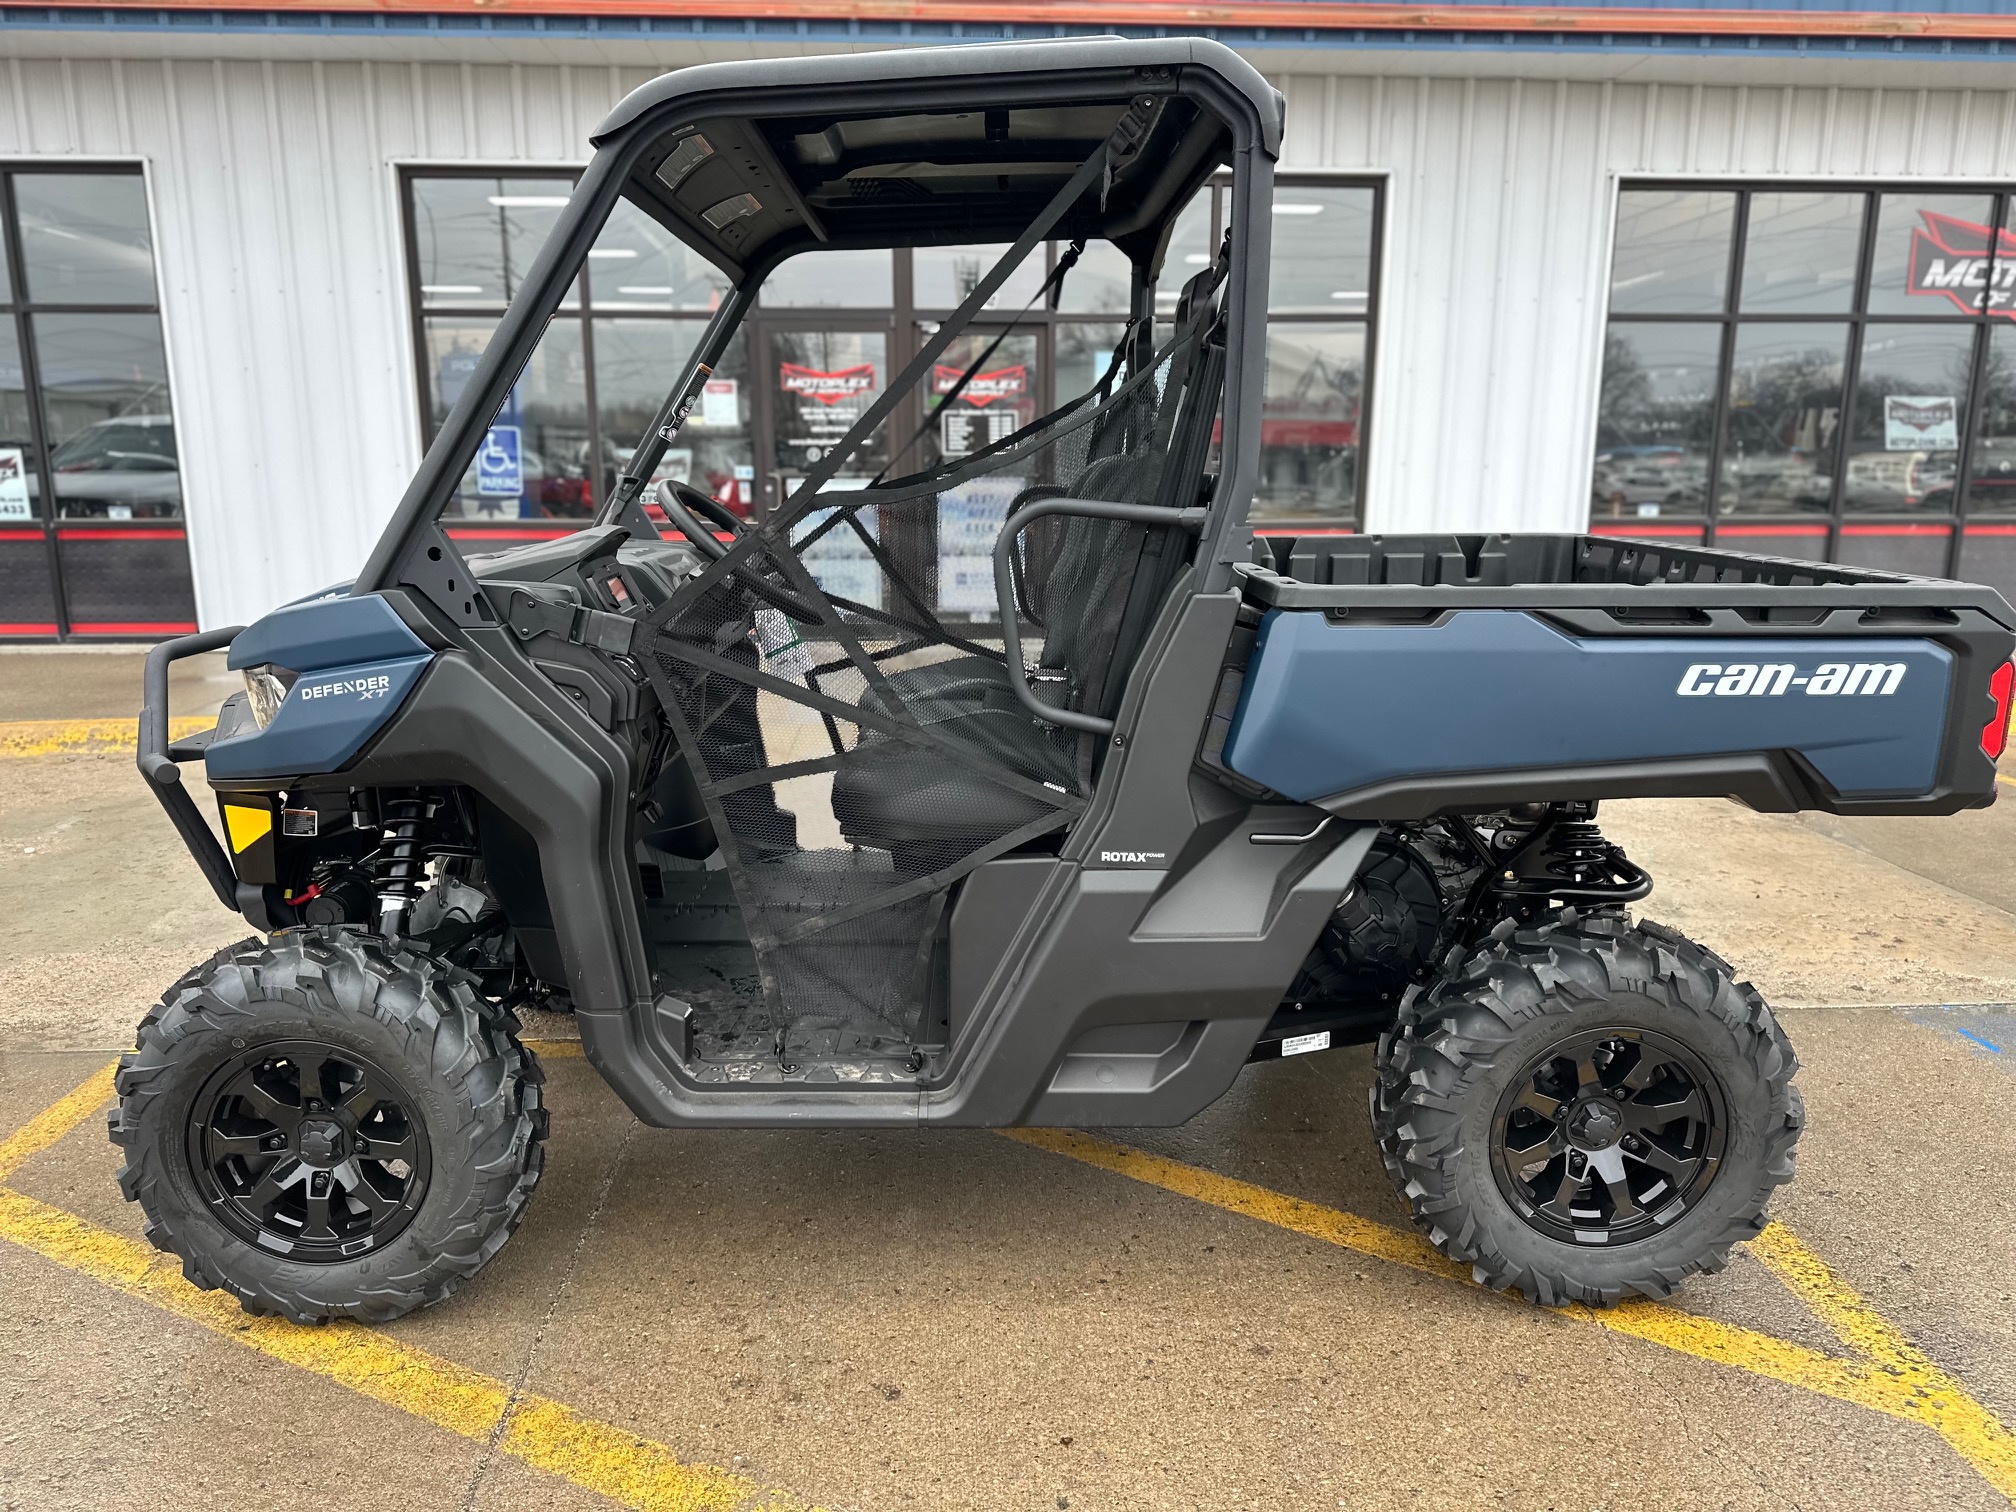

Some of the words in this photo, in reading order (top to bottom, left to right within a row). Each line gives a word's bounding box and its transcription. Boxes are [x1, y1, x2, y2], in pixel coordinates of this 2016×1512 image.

[786, 377, 871, 388] MOTOPLEX
[480, 476, 520, 488] PARKING
[1676, 662, 1908, 696] can-am
[301, 675, 390, 701] DEFENDER
[359, 687, 389, 701] XT
[1101, 851, 1147, 863] ROTAX
